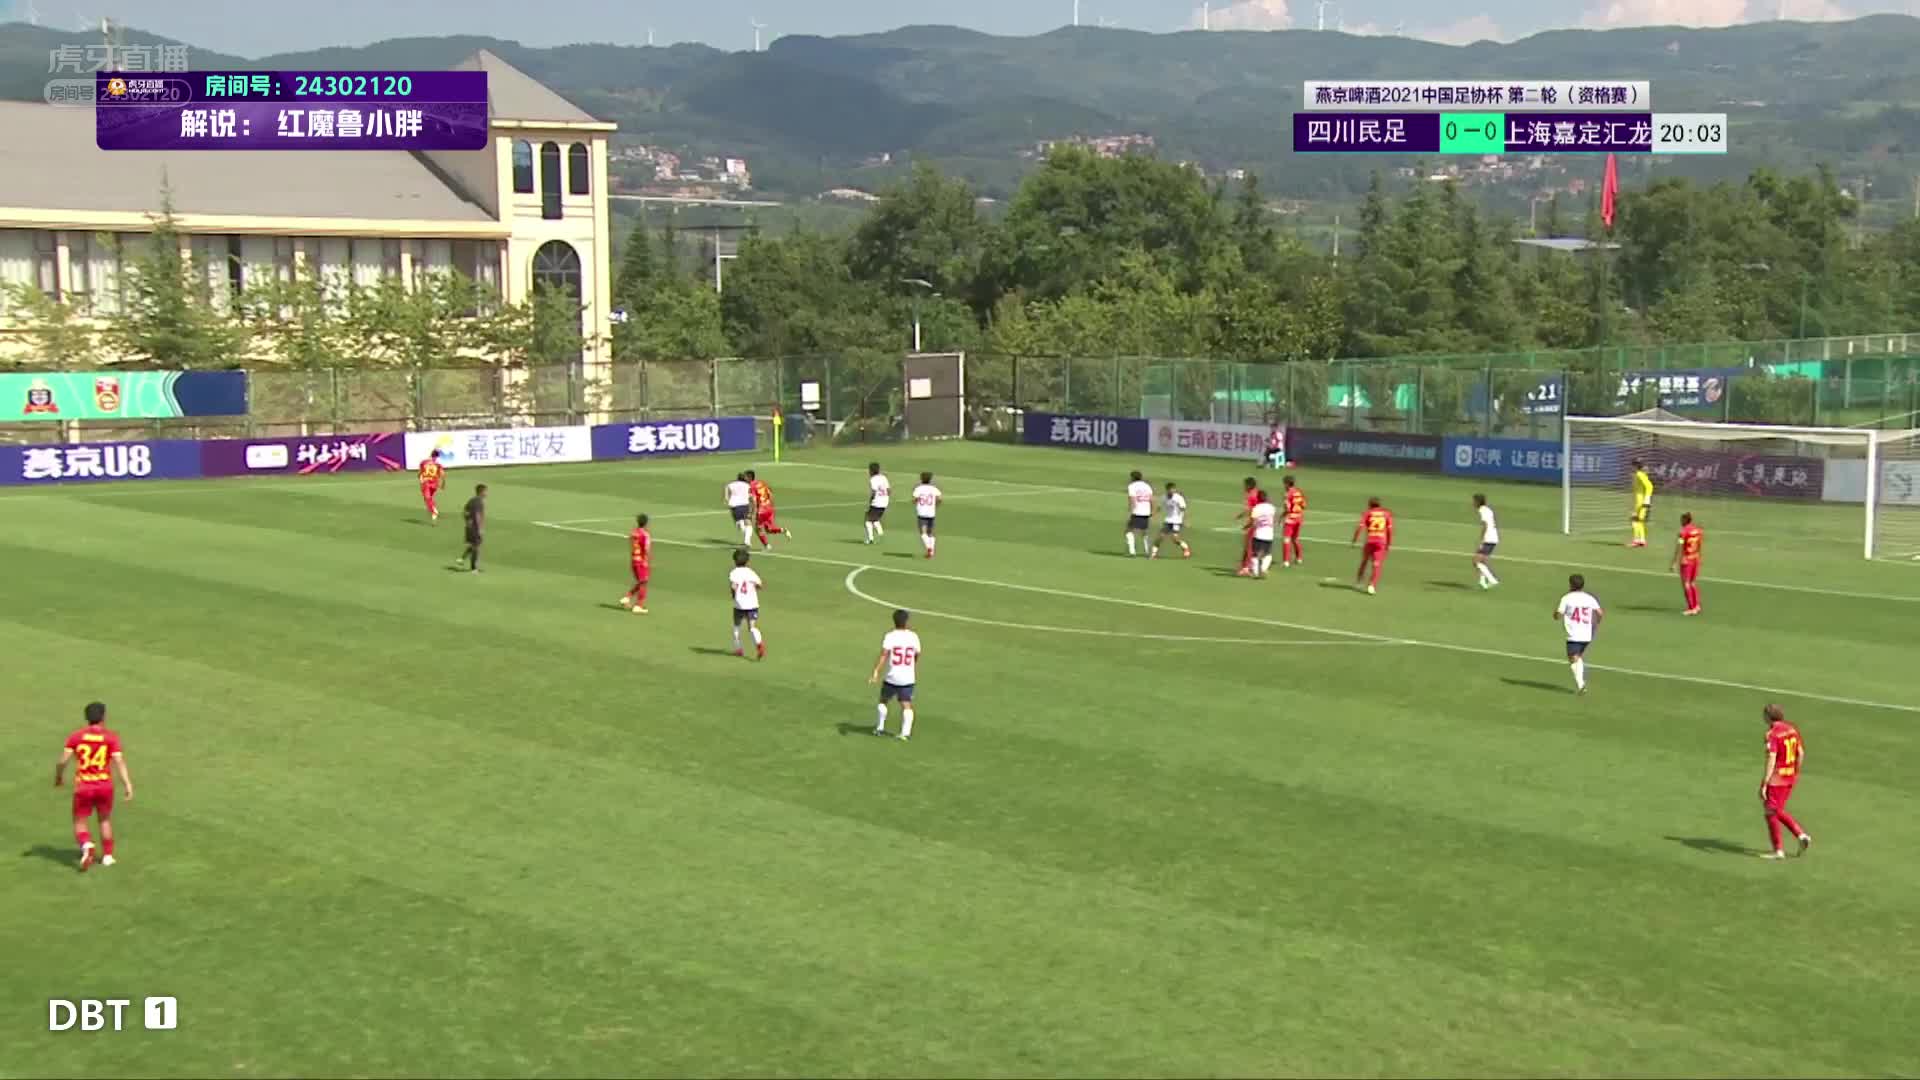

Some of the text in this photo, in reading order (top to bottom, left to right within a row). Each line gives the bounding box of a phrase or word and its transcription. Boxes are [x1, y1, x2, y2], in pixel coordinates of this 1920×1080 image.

[628, 422, 720, 451] 燕京U8
[1050, 417, 1119, 447] 燕京U8
[1177, 428, 1271, 452] 云南省足球协
[466, 433, 566, 461] 嘉定城发
[22, 445, 152, 479] 燕京U8
[1570, 606, 1591, 625] 45
[892, 646, 914, 666] 56
[76, 744, 108, 770] 34
